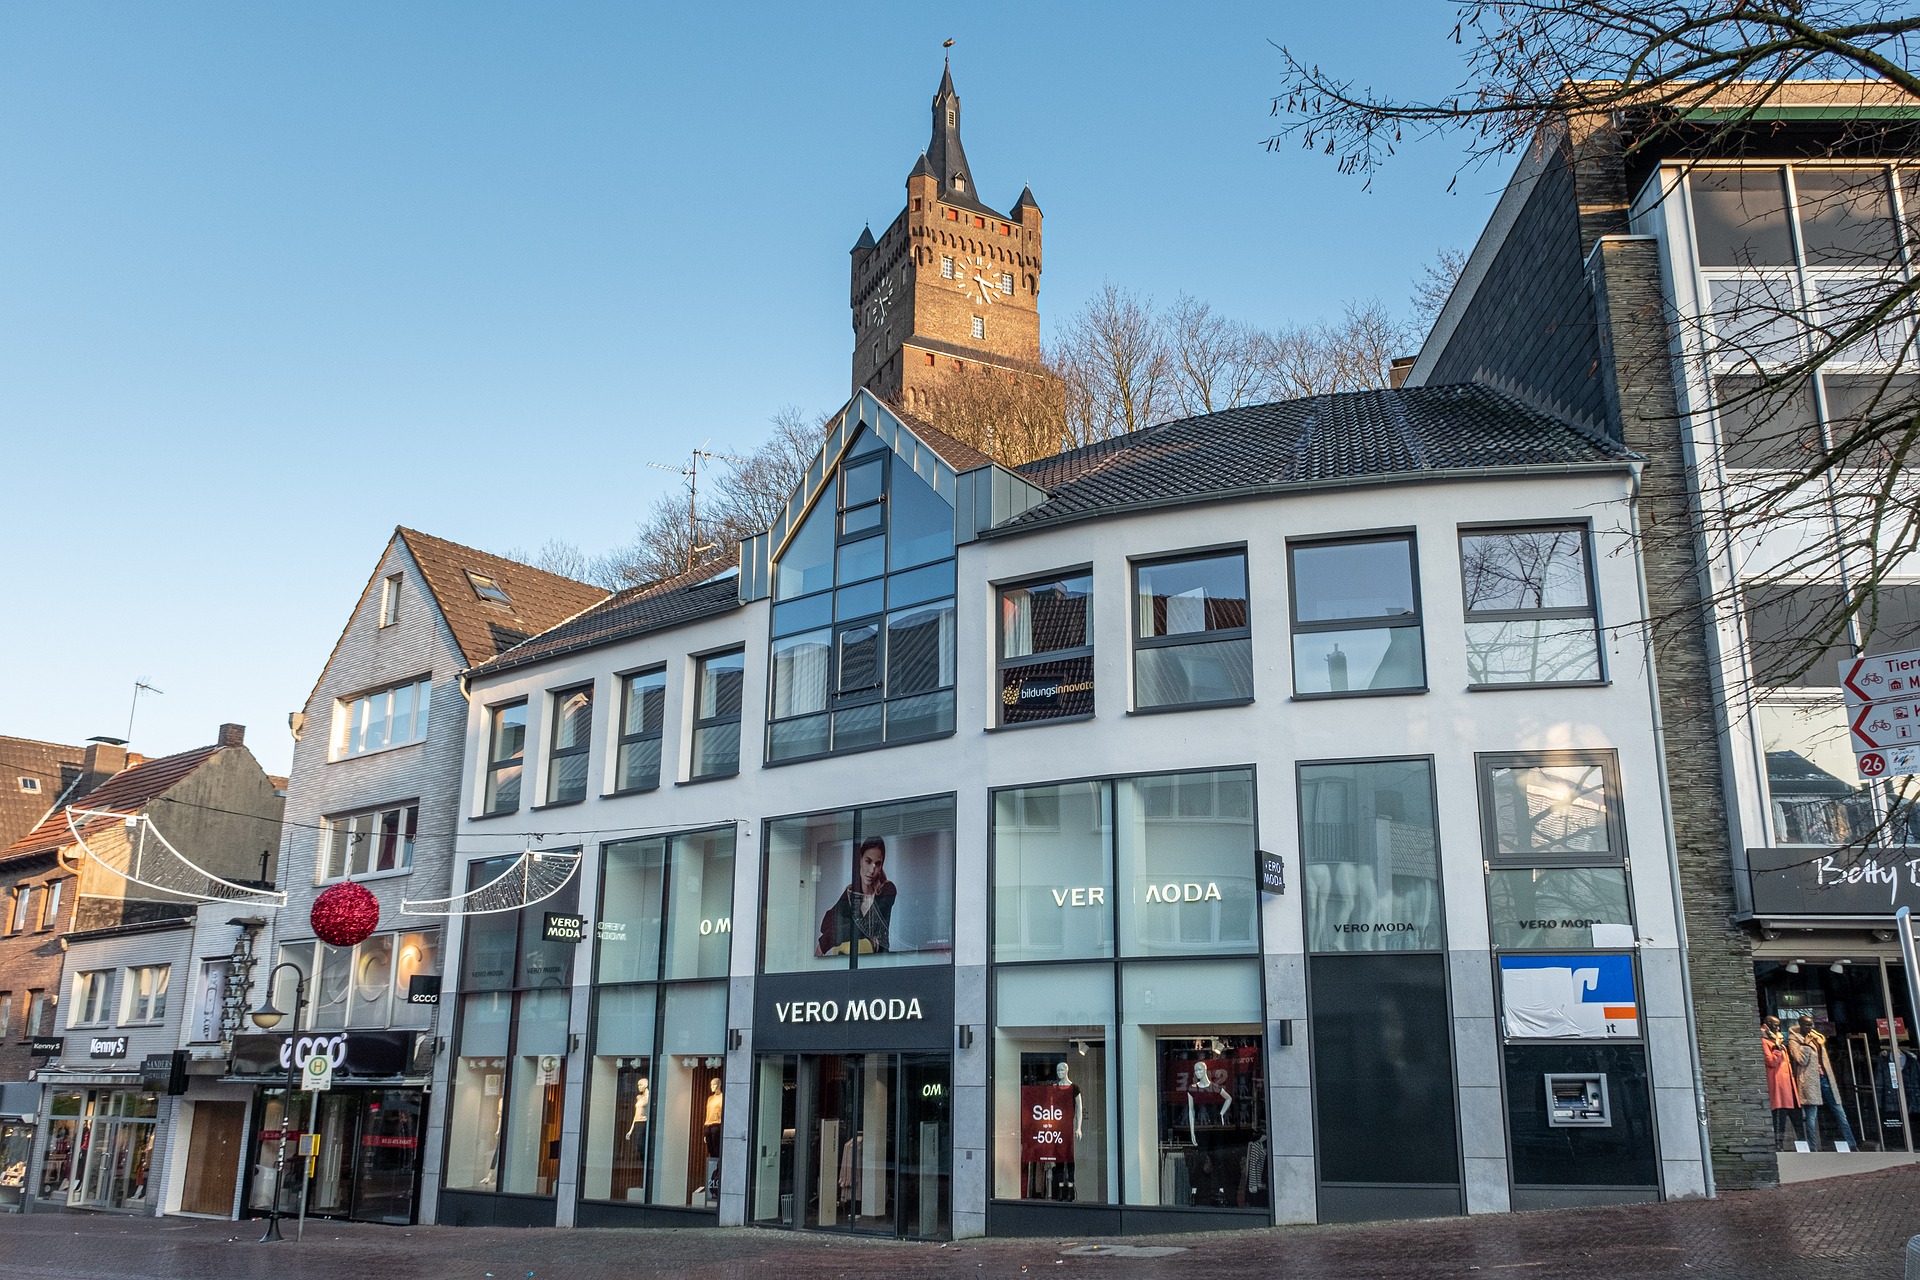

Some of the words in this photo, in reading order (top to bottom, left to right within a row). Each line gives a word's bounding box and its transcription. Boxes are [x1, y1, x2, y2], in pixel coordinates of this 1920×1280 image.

[1862, 757, 1883, 773] 26
[1265, 859, 1281, 874] VERO
[1263, 872, 1283, 887] MODA
[1811, 855, 1898, 906] Betty
[1051, 886, 1105, 907] VER
[550, 917, 579, 928] VERO
[1333, 923, 1370, 933] VERO
[1373, 923, 1415, 932] MODA
[1518, 919, 1557, 929] VERO
[547, 927, 581, 938] MODA
[412, 994, 439, 1003] ecco
[775, 1001, 839, 1023] VERO
[844, 998, 923, 1021] MODA
[33, 1042, 54, 1050] Kenny
[90, 1038, 117, 1056] Kenny
[1032, 1104, 1063, 1121] Sale
[1032, 1130, 1063, 1144] -50%
